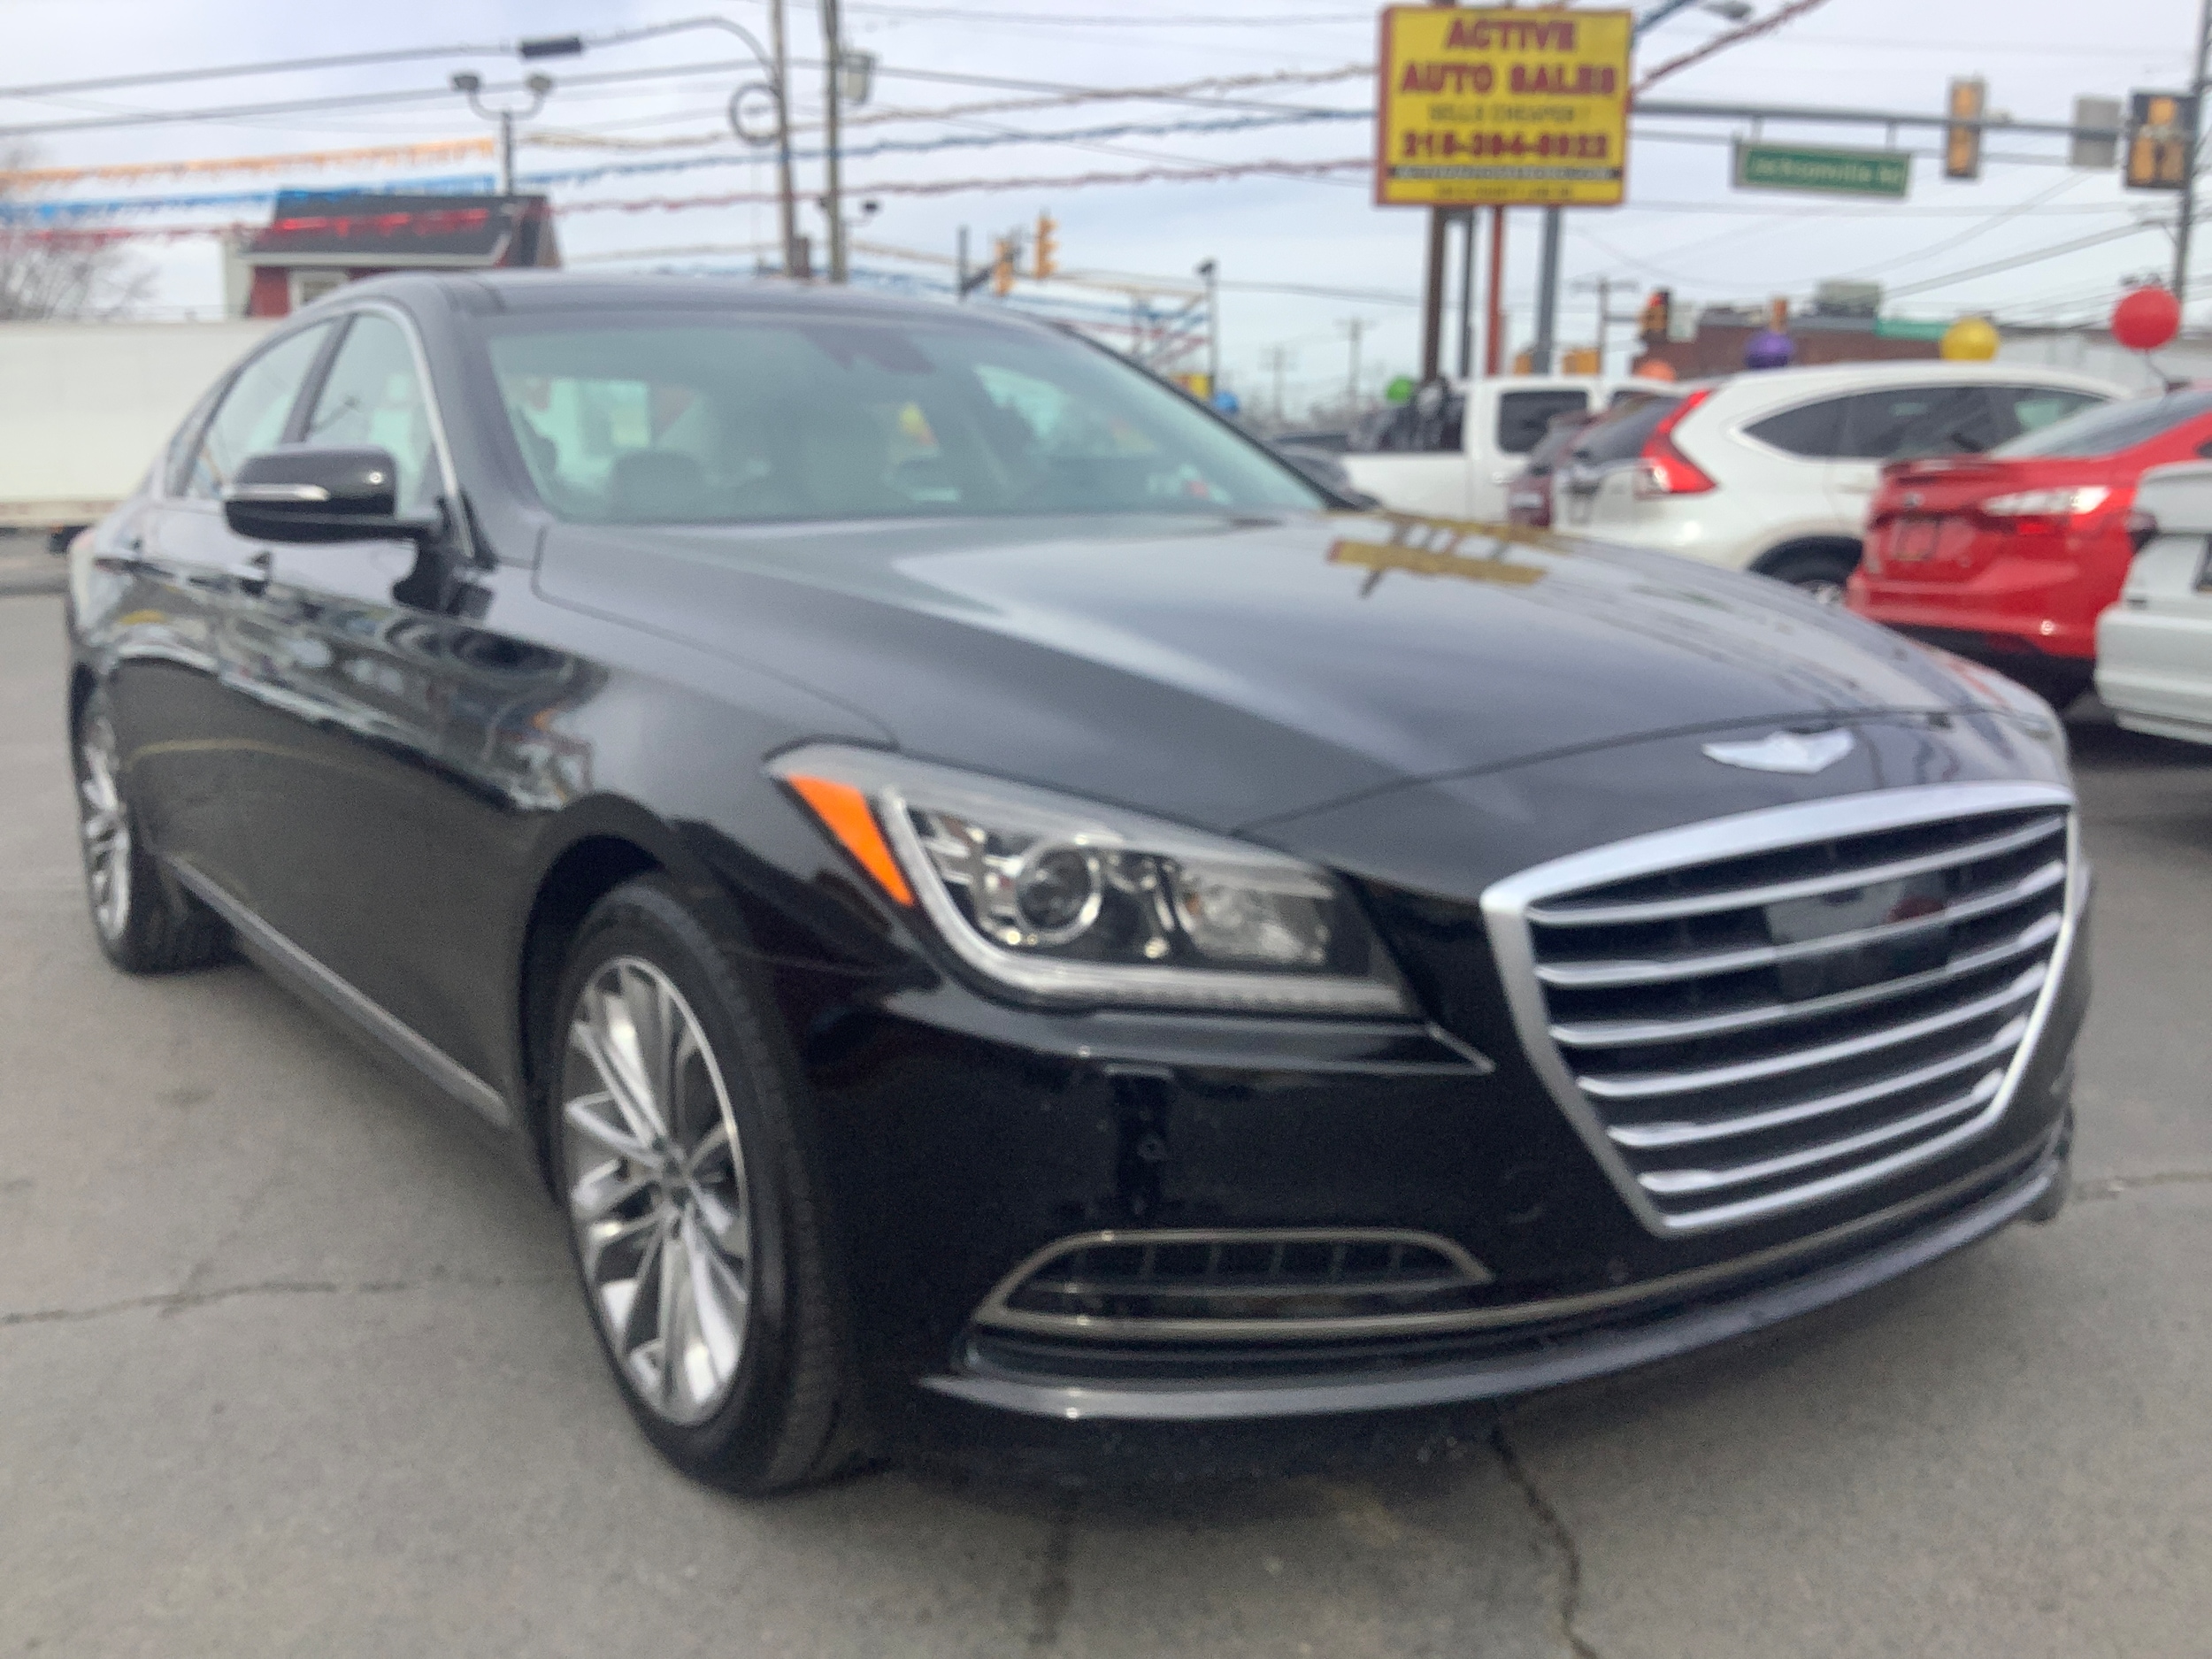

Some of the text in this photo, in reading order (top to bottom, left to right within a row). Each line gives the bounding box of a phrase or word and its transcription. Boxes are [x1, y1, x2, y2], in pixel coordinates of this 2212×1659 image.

[1447, 19, 1575, 50] ACTIVE
[1402, 63, 1616, 95] AUTO SALES
